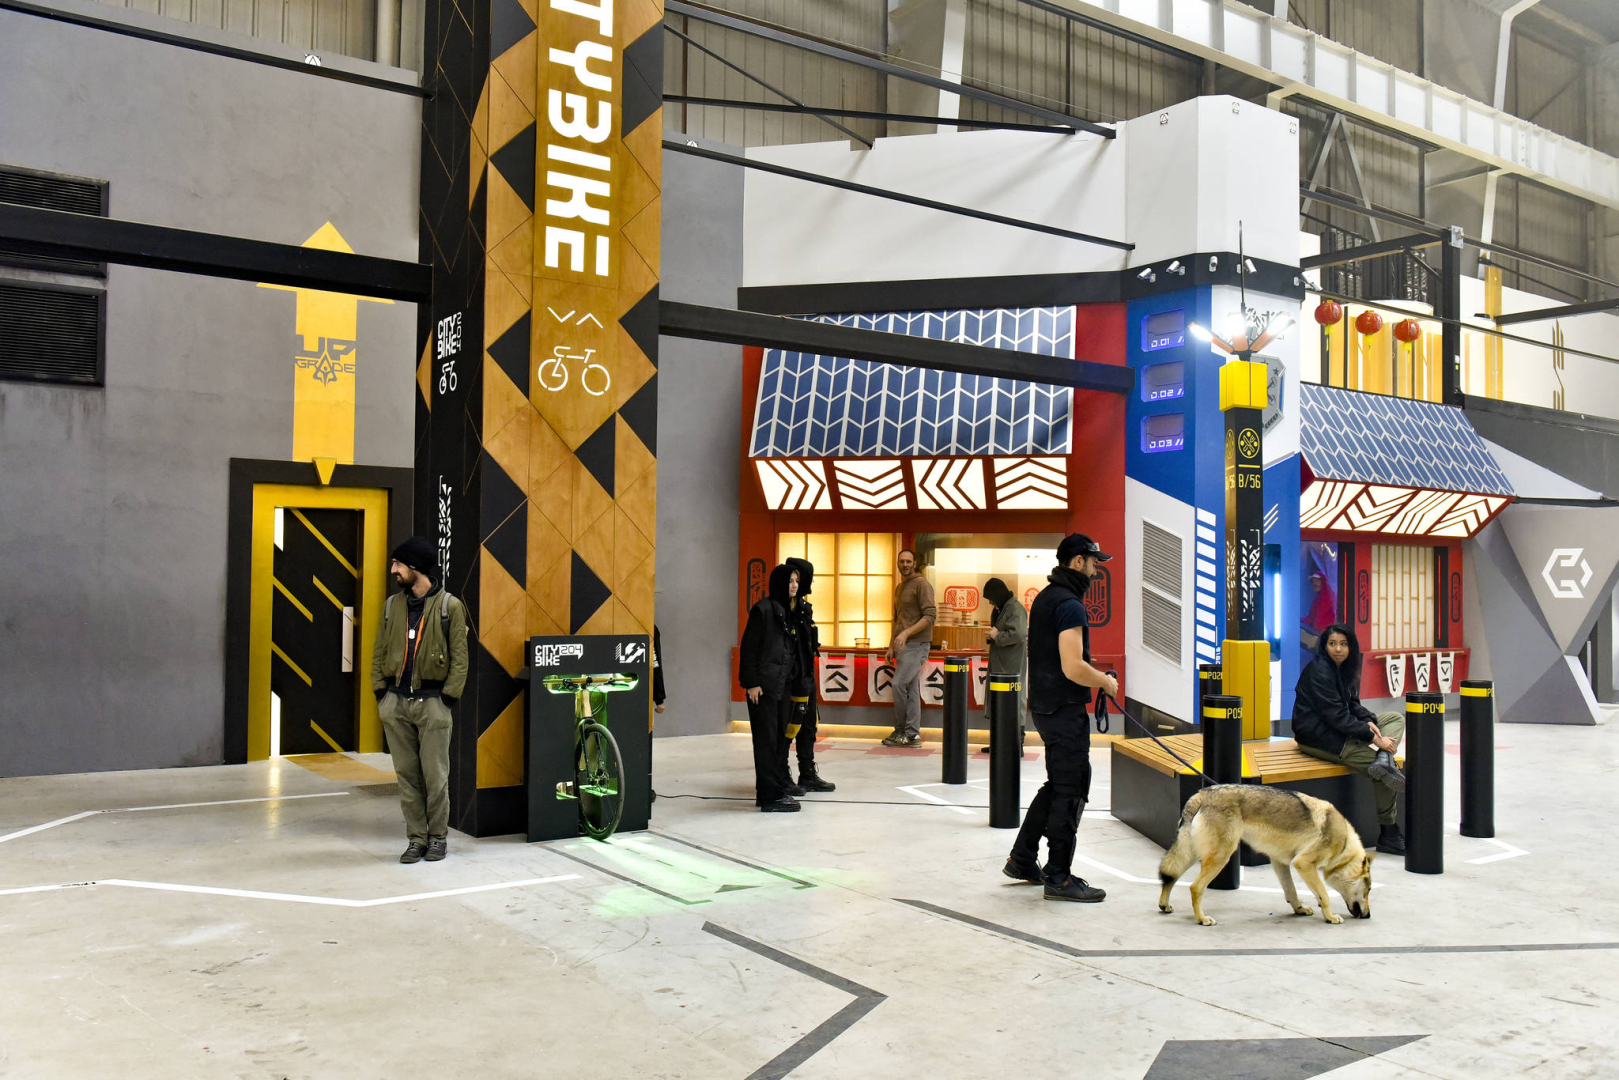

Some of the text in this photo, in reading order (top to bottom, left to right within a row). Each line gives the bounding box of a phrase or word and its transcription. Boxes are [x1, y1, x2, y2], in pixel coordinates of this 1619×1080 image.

[437, 313, 457, 340] CITY
[295, 334, 356, 361] UP
[437, 332, 457, 360] BIKE
[295, 356, 356, 381] GRADE
[1238, 473, 1261, 489] B/56
[535, 645, 560, 657] CITY
[535, 654, 560, 667] BIKE
[1207, 671, 1221, 680] P02
[1226, 708, 1242, 720] P05
[1423, 702, 1441, 714] P04
